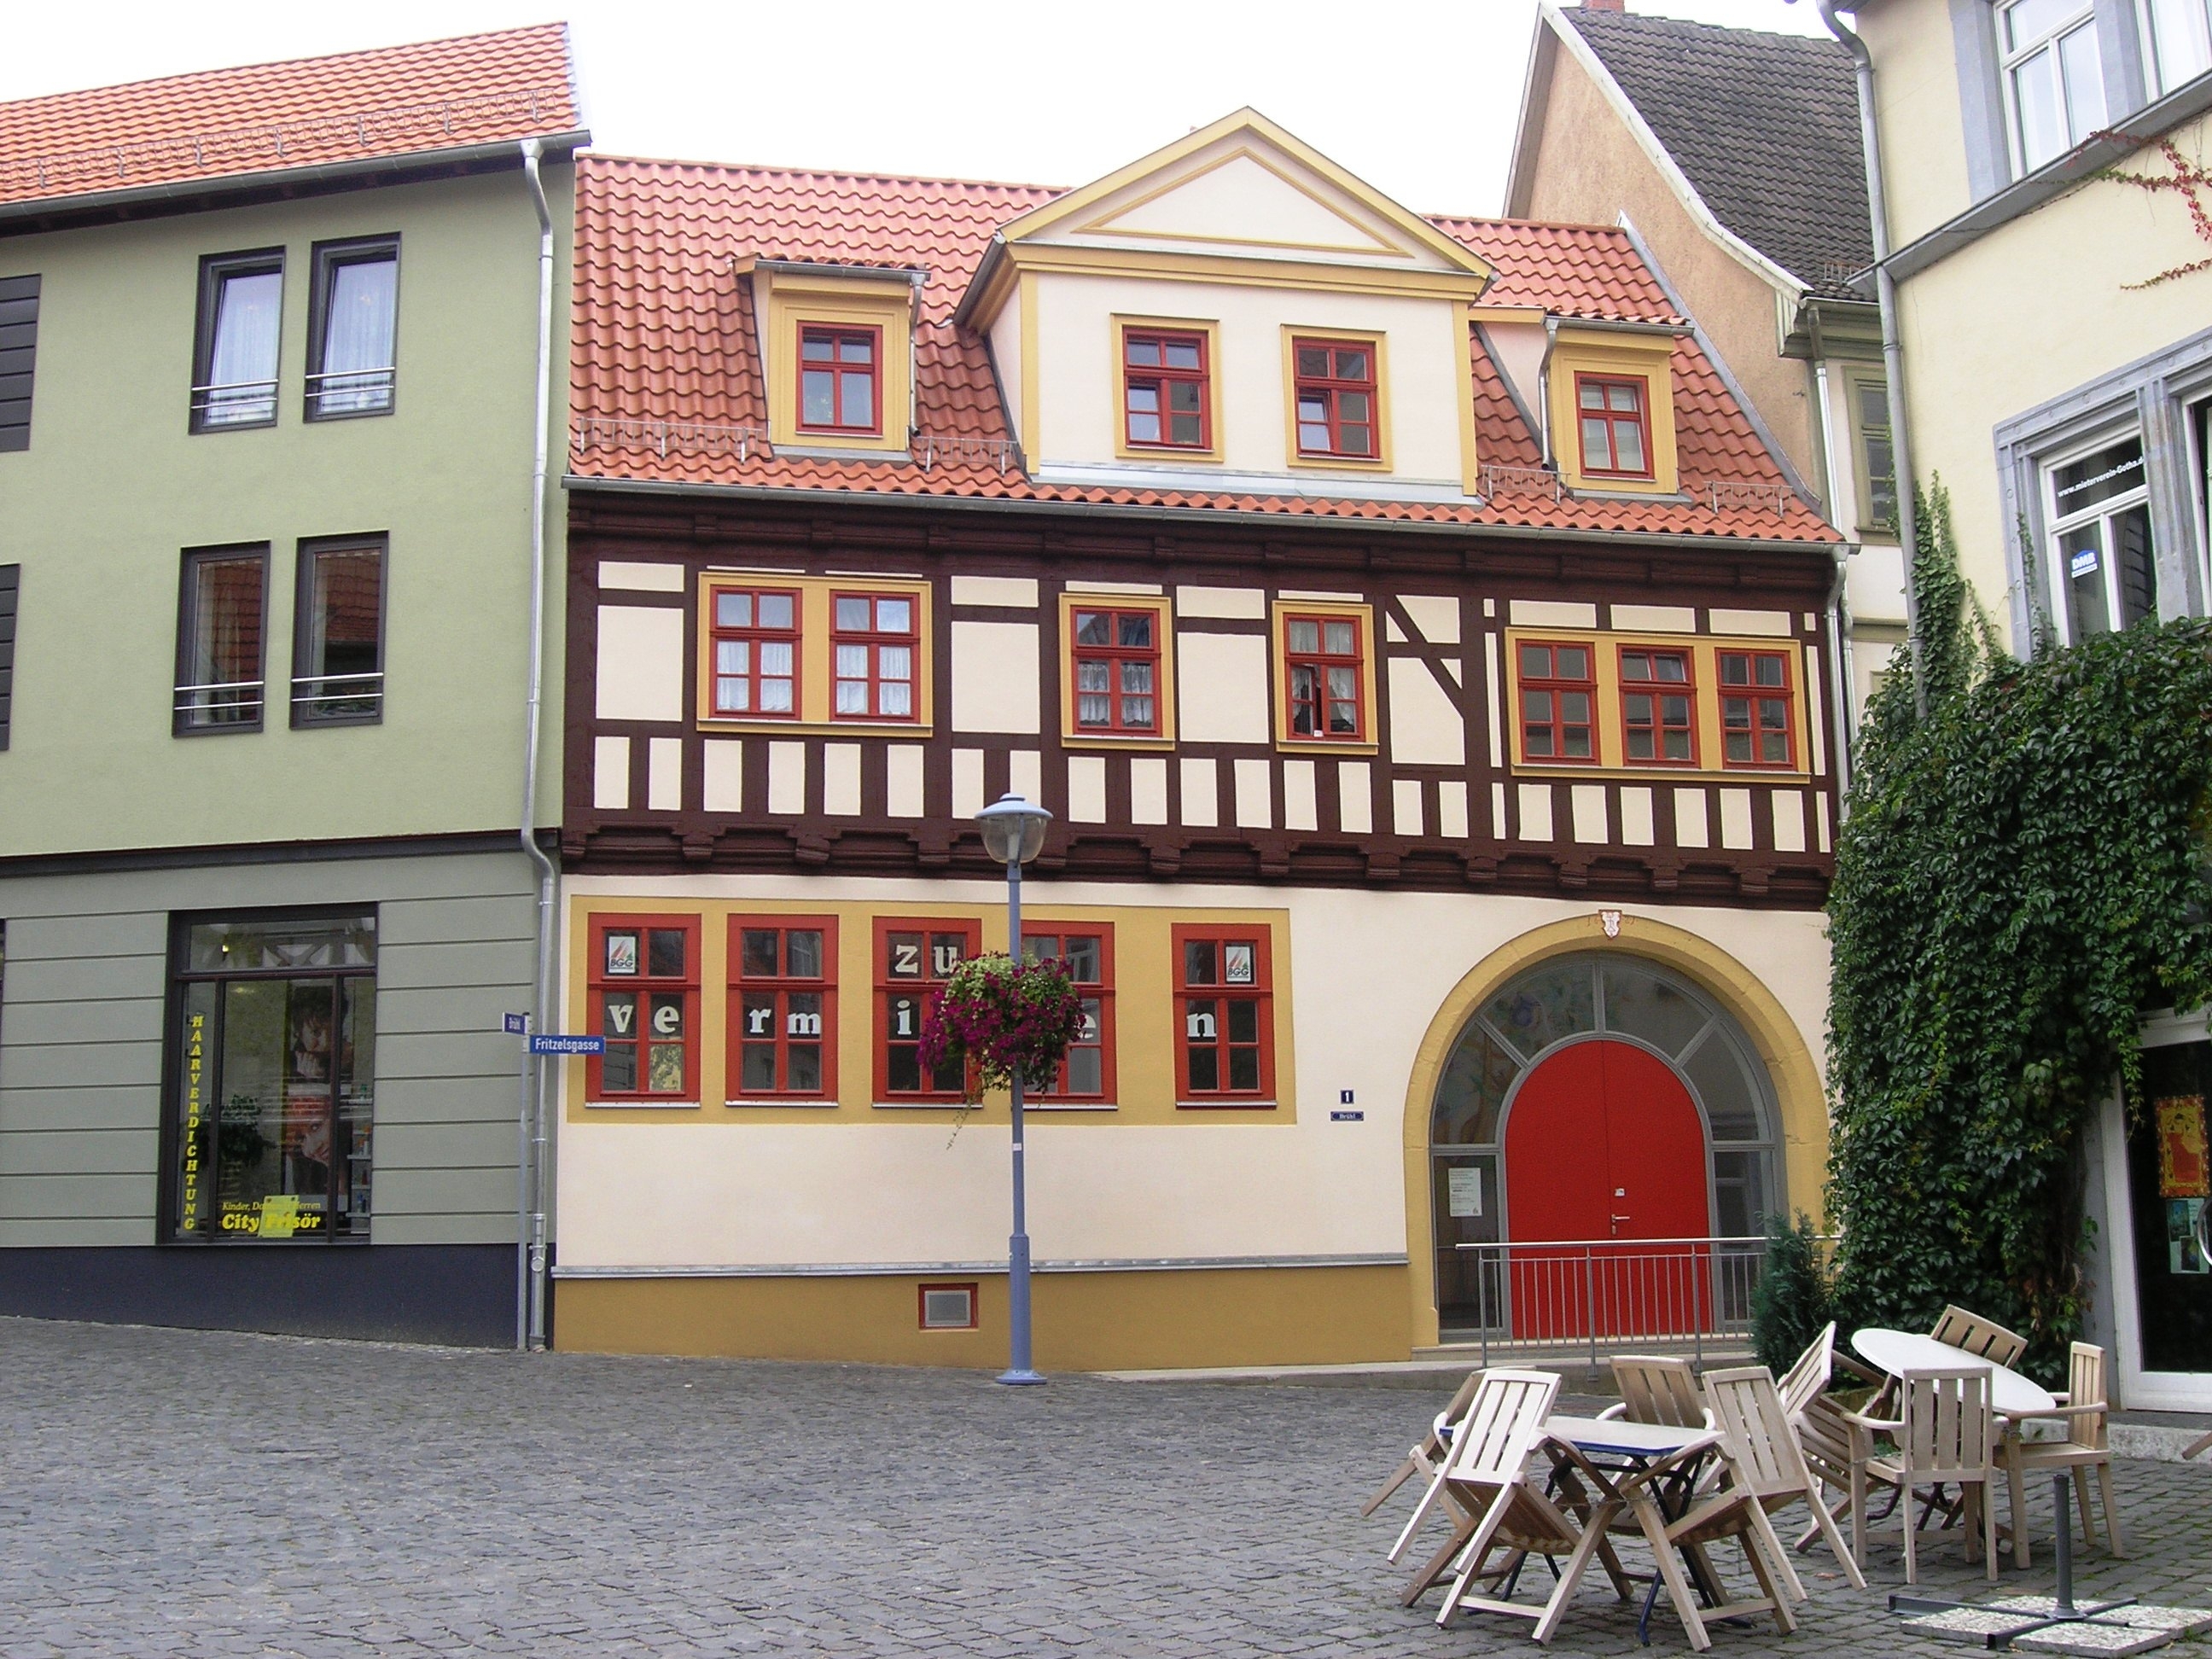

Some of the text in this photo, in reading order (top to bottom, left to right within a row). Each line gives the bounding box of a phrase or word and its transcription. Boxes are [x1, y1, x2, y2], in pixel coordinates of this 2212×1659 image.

[2071, 552, 2096, 570] DMB
[609, 958, 633, 968] BGG
[895, 944, 958, 974] zu
[1227, 967, 1249, 976] BGG
[535, 1038, 600, 1053] Fritzelsgasse
[1345, 1091, 1350, 1103] 1
[184, 1015, 204, 1231] HAARVERDICHTUNG
[222, 1202, 251, 1212] Kinder,
[222, 1214, 259, 1233] City
